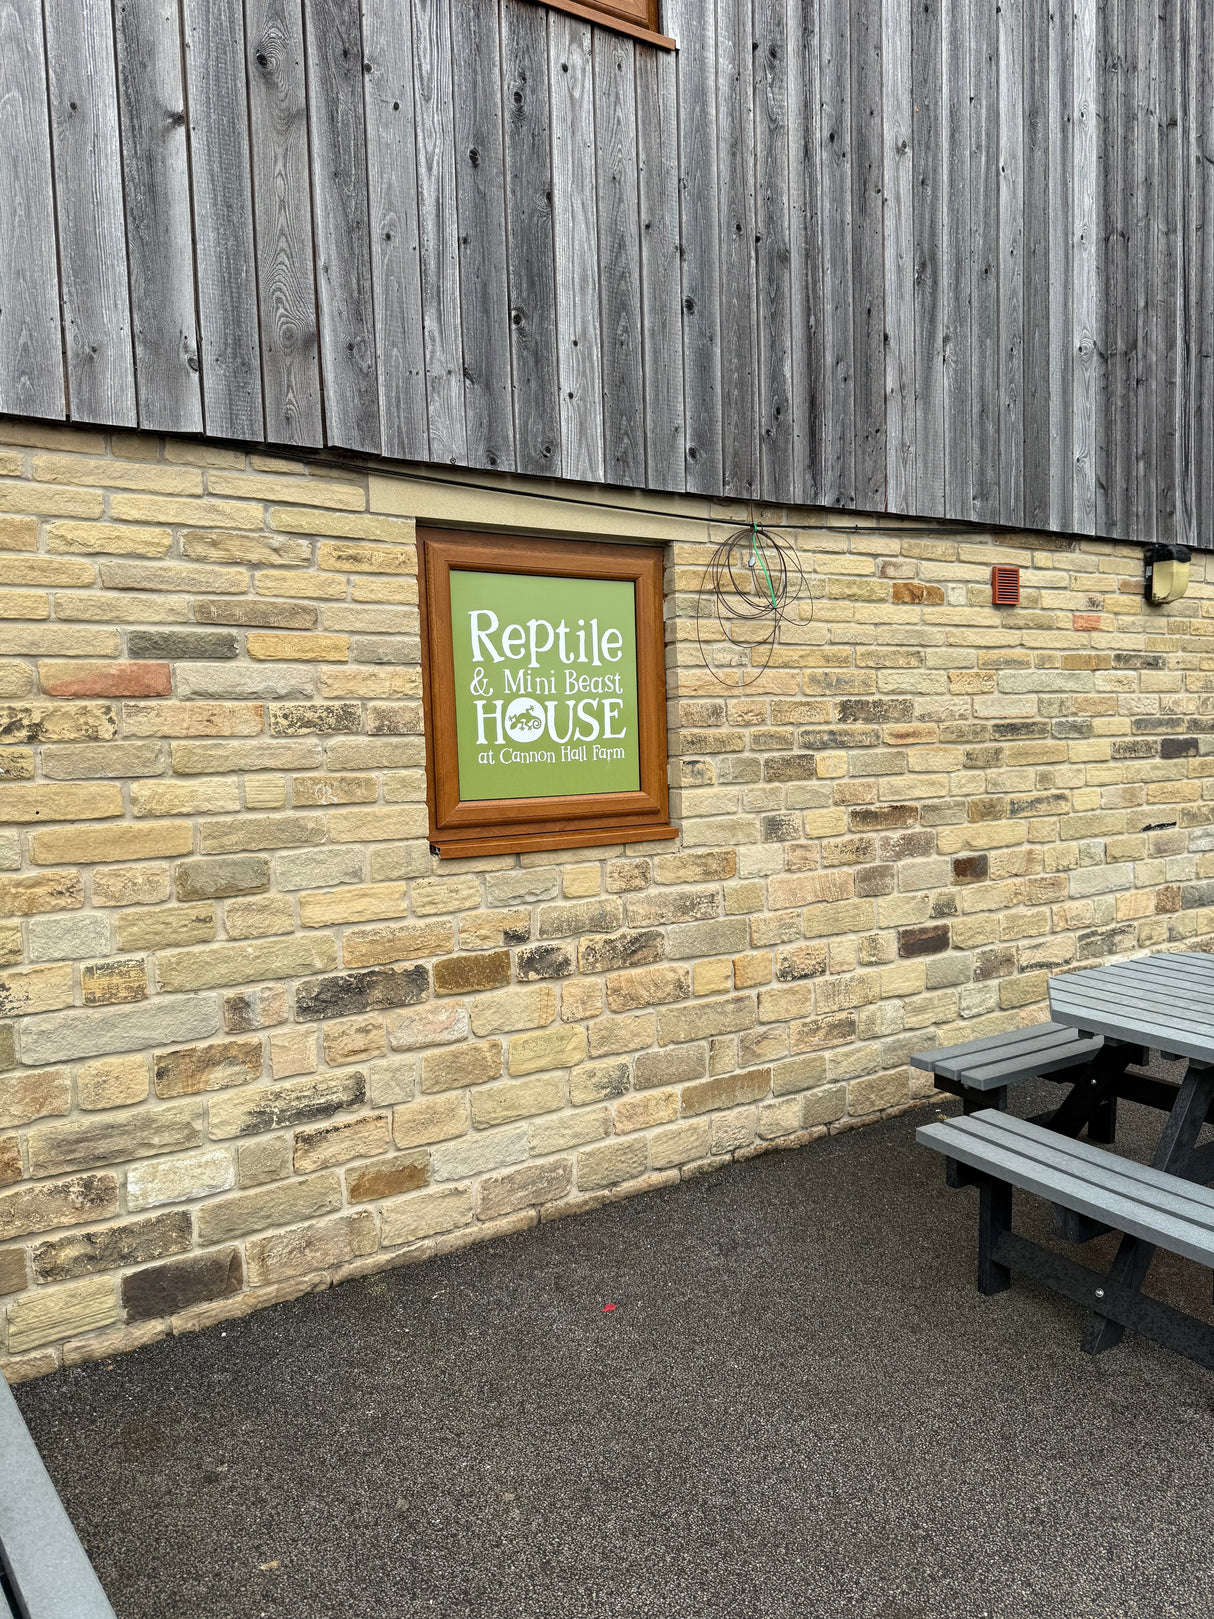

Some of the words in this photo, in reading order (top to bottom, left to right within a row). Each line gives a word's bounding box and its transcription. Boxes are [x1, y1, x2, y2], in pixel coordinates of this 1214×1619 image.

[468, 609, 623, 668] Reptile
[470, 666, 493, 696] &
[503, 669, 557, 695] Mini
[564, 669, 623, 695] Beast
[473, 697, 627, 745] HOUSE
[478, 749, 496, 765] at
[499, 748, 556, 765] Cannon
[560, 745, 587, 762] Hall
[592, 744, 625, 761] Farm
